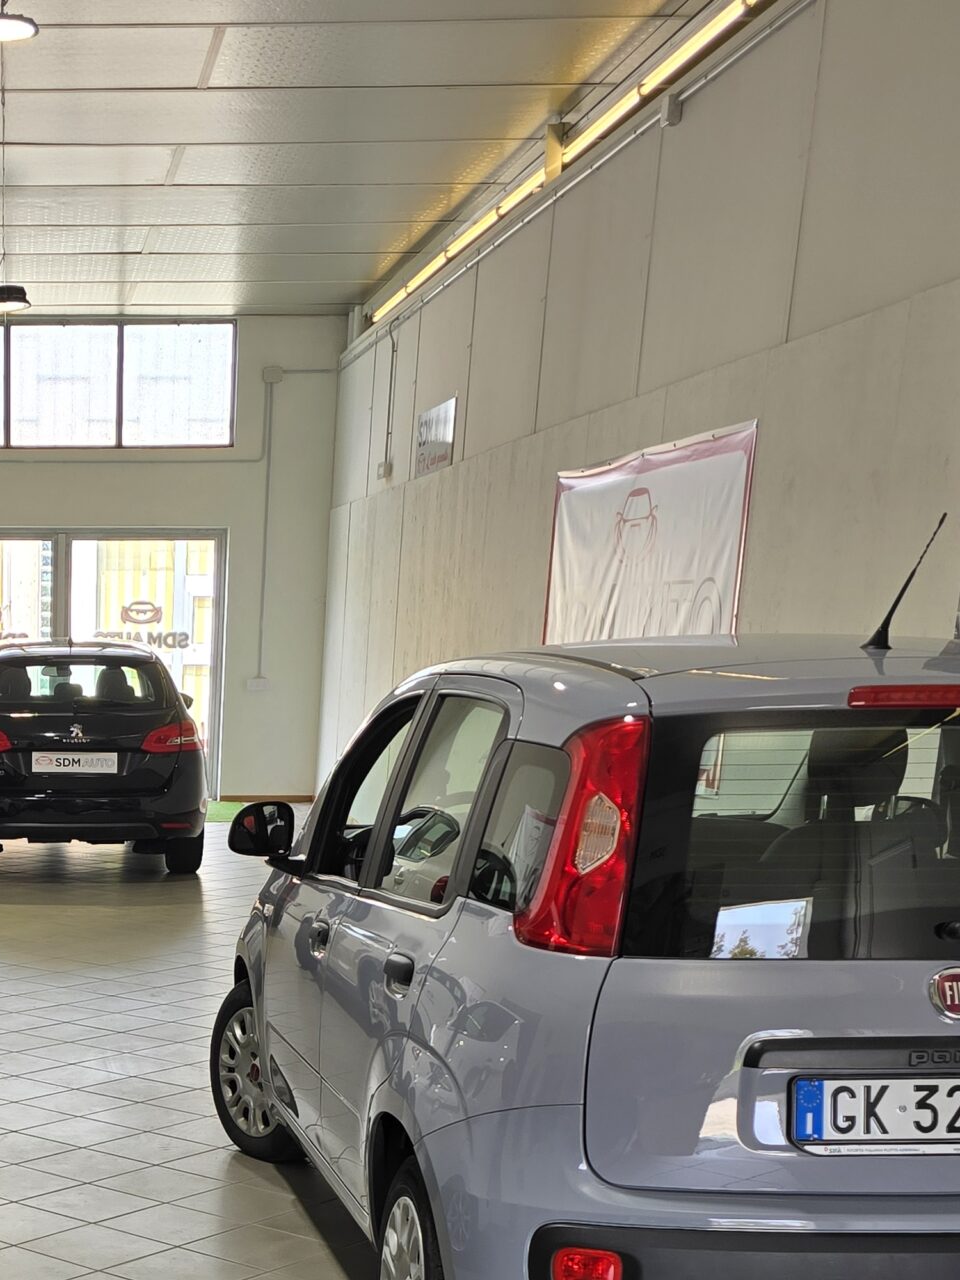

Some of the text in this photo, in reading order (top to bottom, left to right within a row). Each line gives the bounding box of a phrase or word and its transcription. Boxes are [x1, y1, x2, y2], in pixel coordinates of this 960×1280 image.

[944, 981, 960, 1005] FI
[909, 1051, 960, 1067] pa
[830, 1085, 890, 1136] GK
